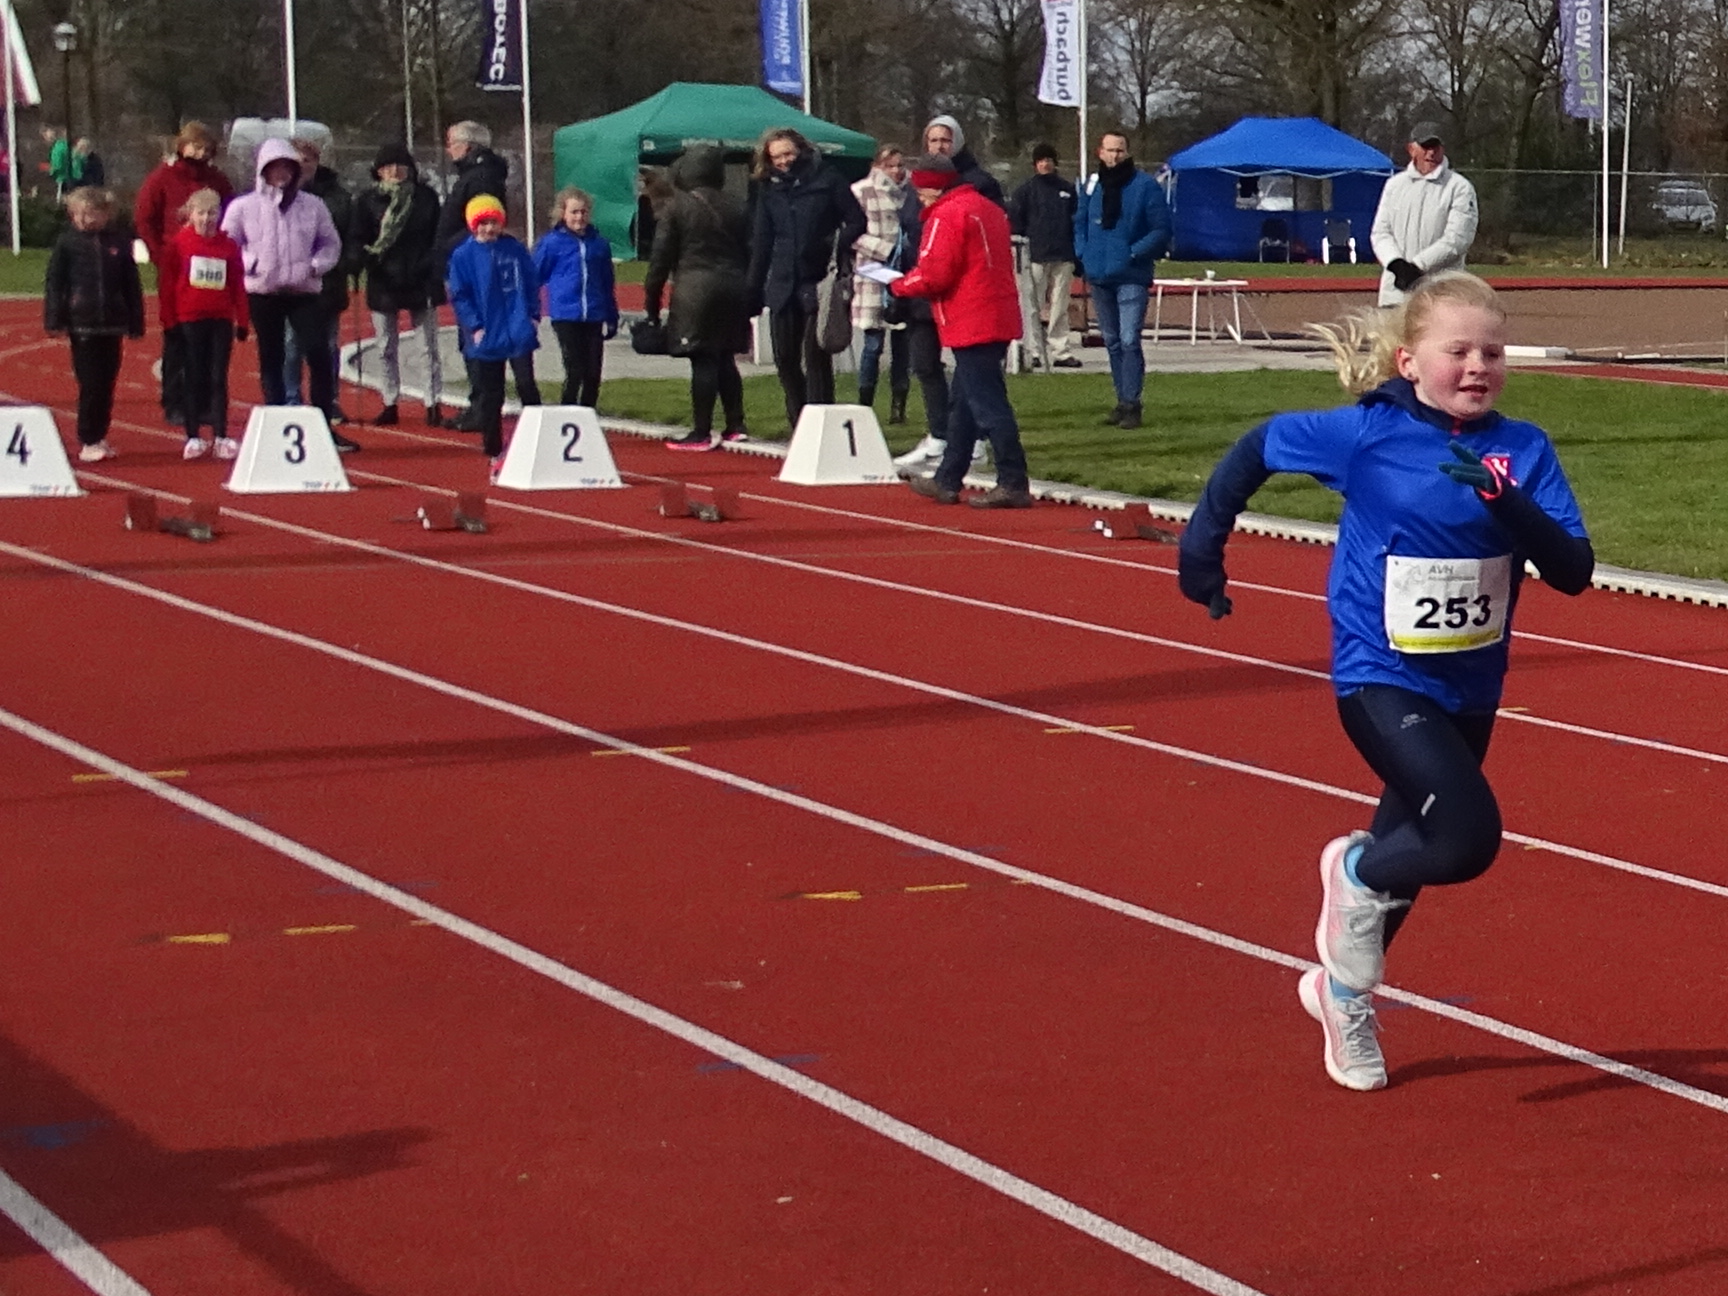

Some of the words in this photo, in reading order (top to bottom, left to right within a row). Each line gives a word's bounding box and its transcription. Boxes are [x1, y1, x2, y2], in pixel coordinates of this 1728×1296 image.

[7, 422, 31, 466] 4
[283, 424, 305, 464] 3
[561, 423, 583, 462] 2
[842, 419, 858, 457] 1
[1413, 594, 1492, 629] 253
